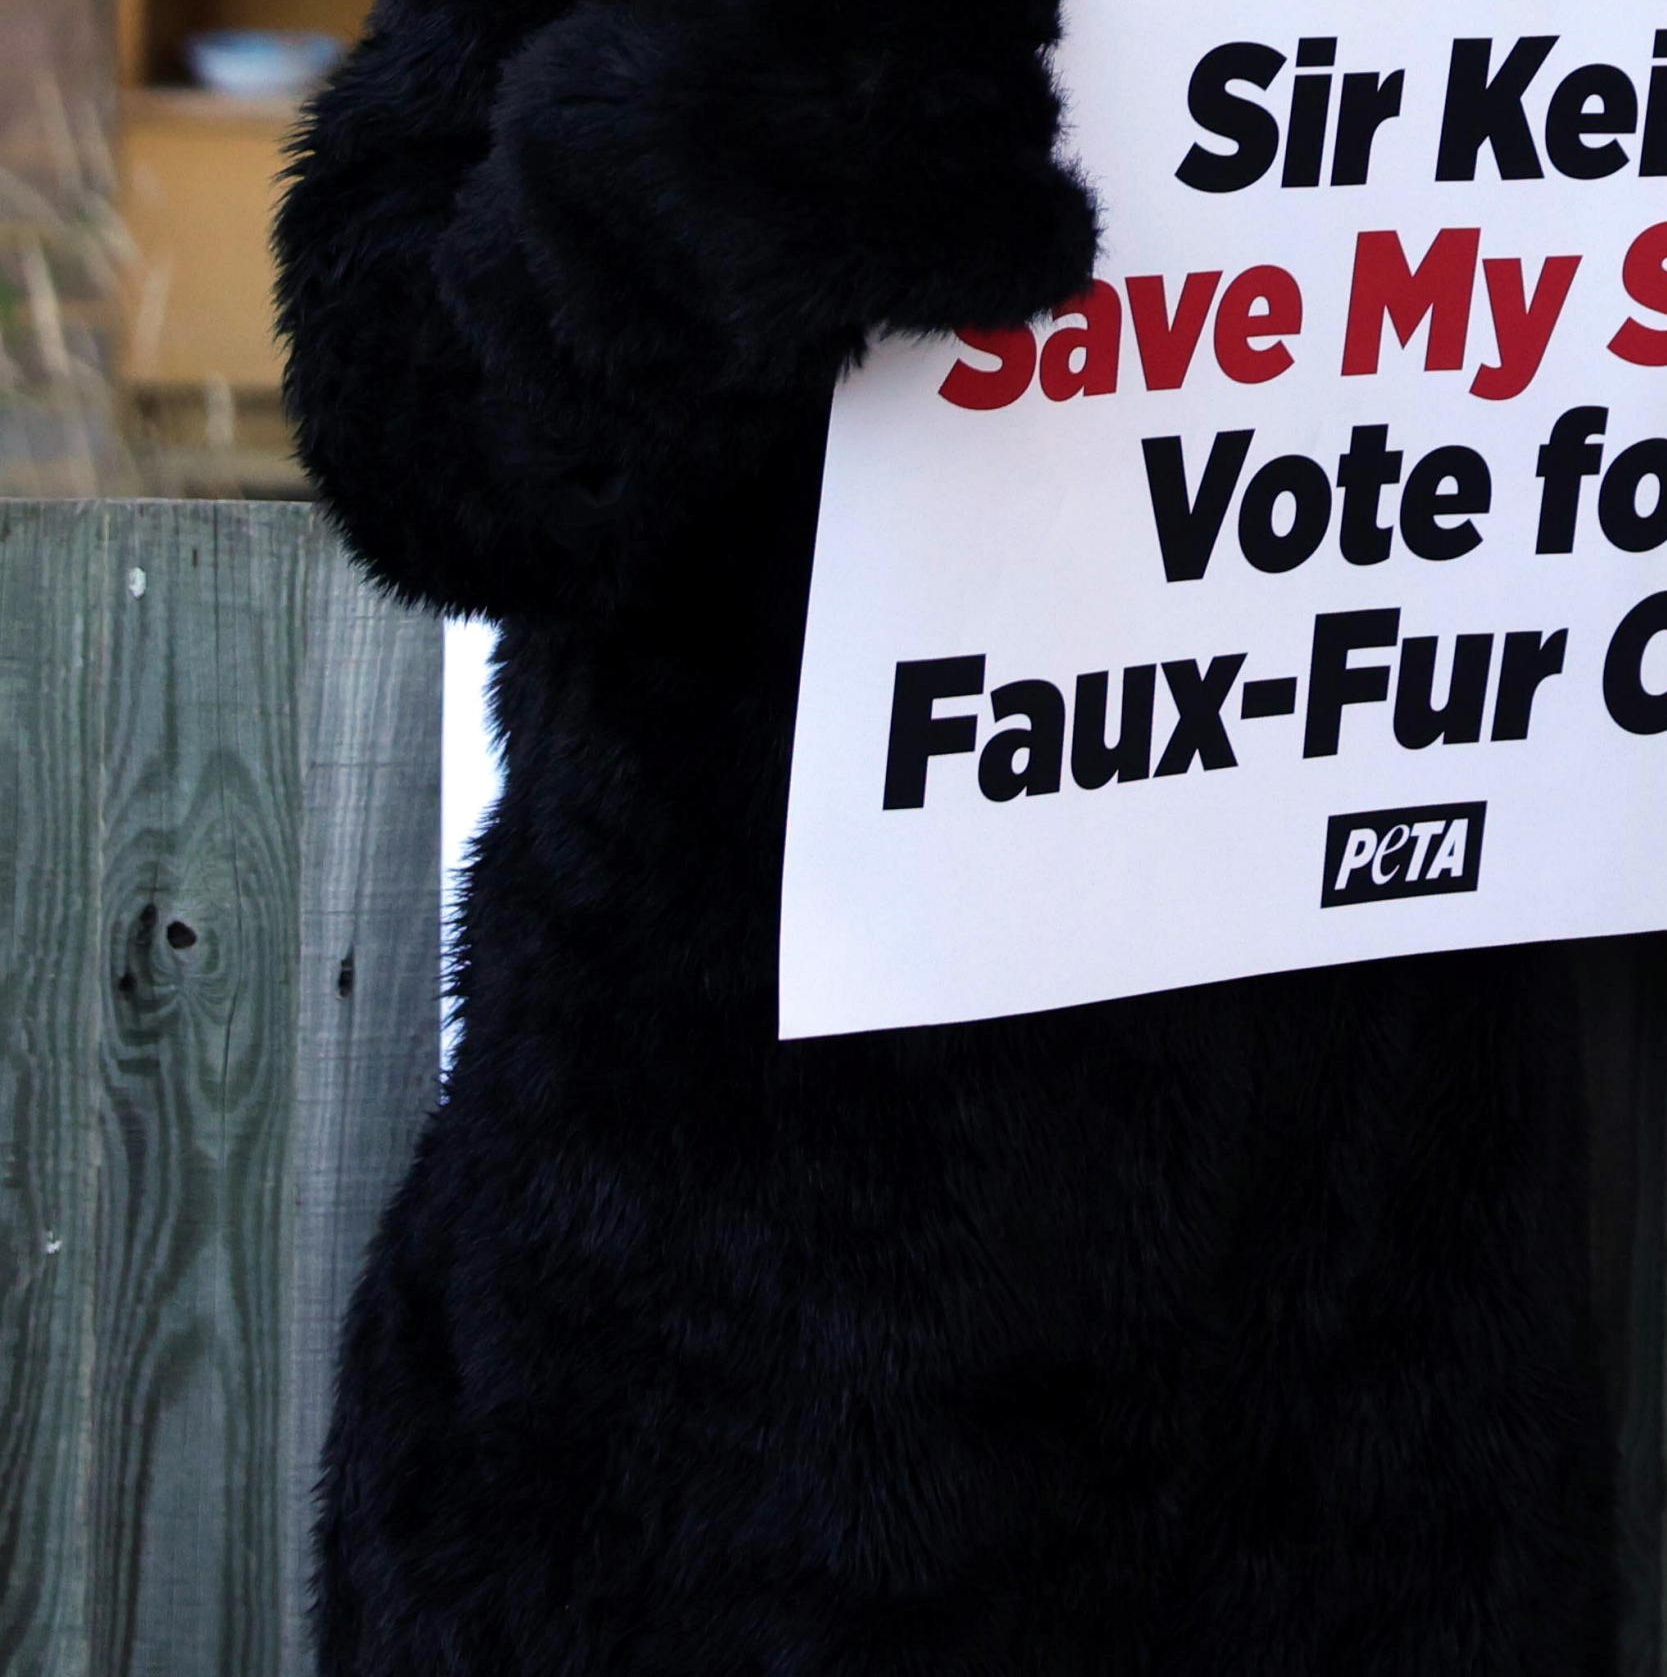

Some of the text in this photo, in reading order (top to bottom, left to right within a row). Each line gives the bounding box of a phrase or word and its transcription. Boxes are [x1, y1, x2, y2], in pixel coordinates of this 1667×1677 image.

[1175, 36, 1404, 193] Sir
[1341, 228, 1581, 400] My
[1142, 424, 1491, 582] Vote
[883, 590, 1568, 810] Faux-Fur
